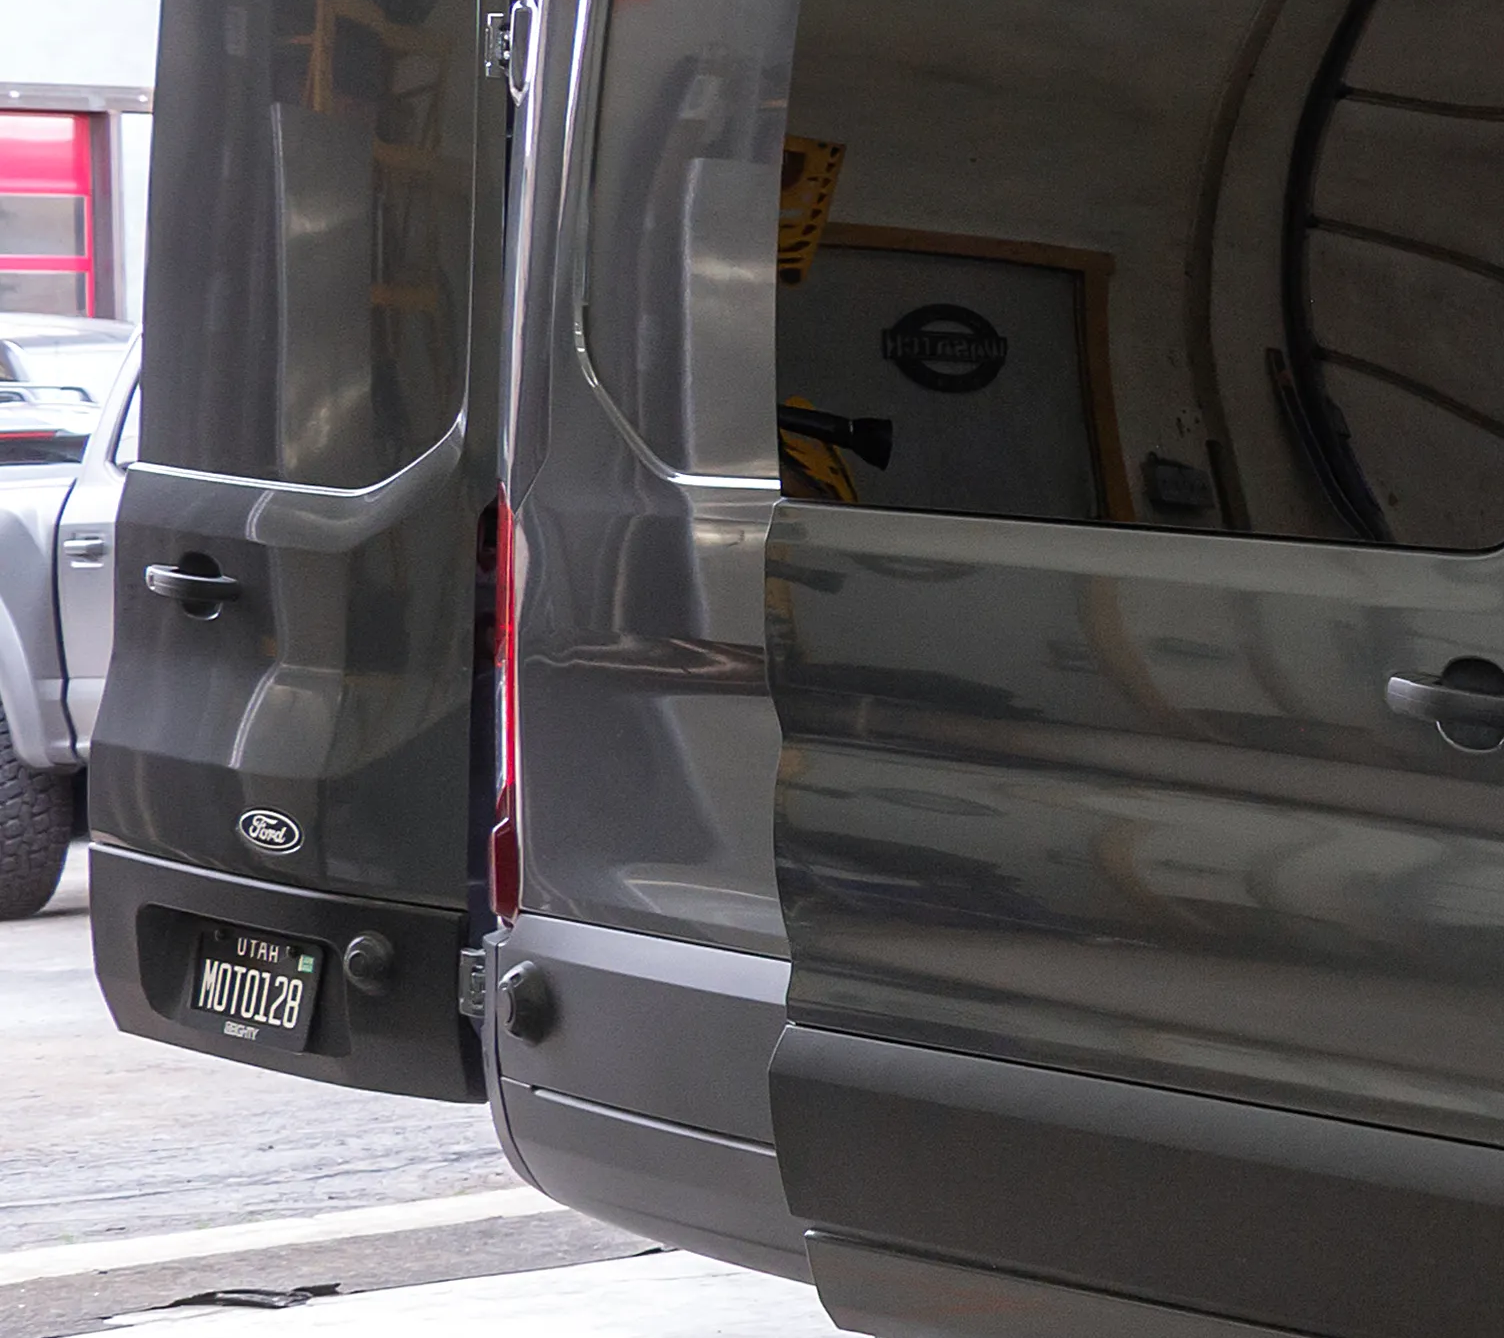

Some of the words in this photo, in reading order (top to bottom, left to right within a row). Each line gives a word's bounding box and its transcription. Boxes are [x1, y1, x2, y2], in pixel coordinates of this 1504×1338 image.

[249, 814, 288, 844] Ford
[236, 937, 280, 963] UTAH
[198, 958, 303, 1029] MOTO128
